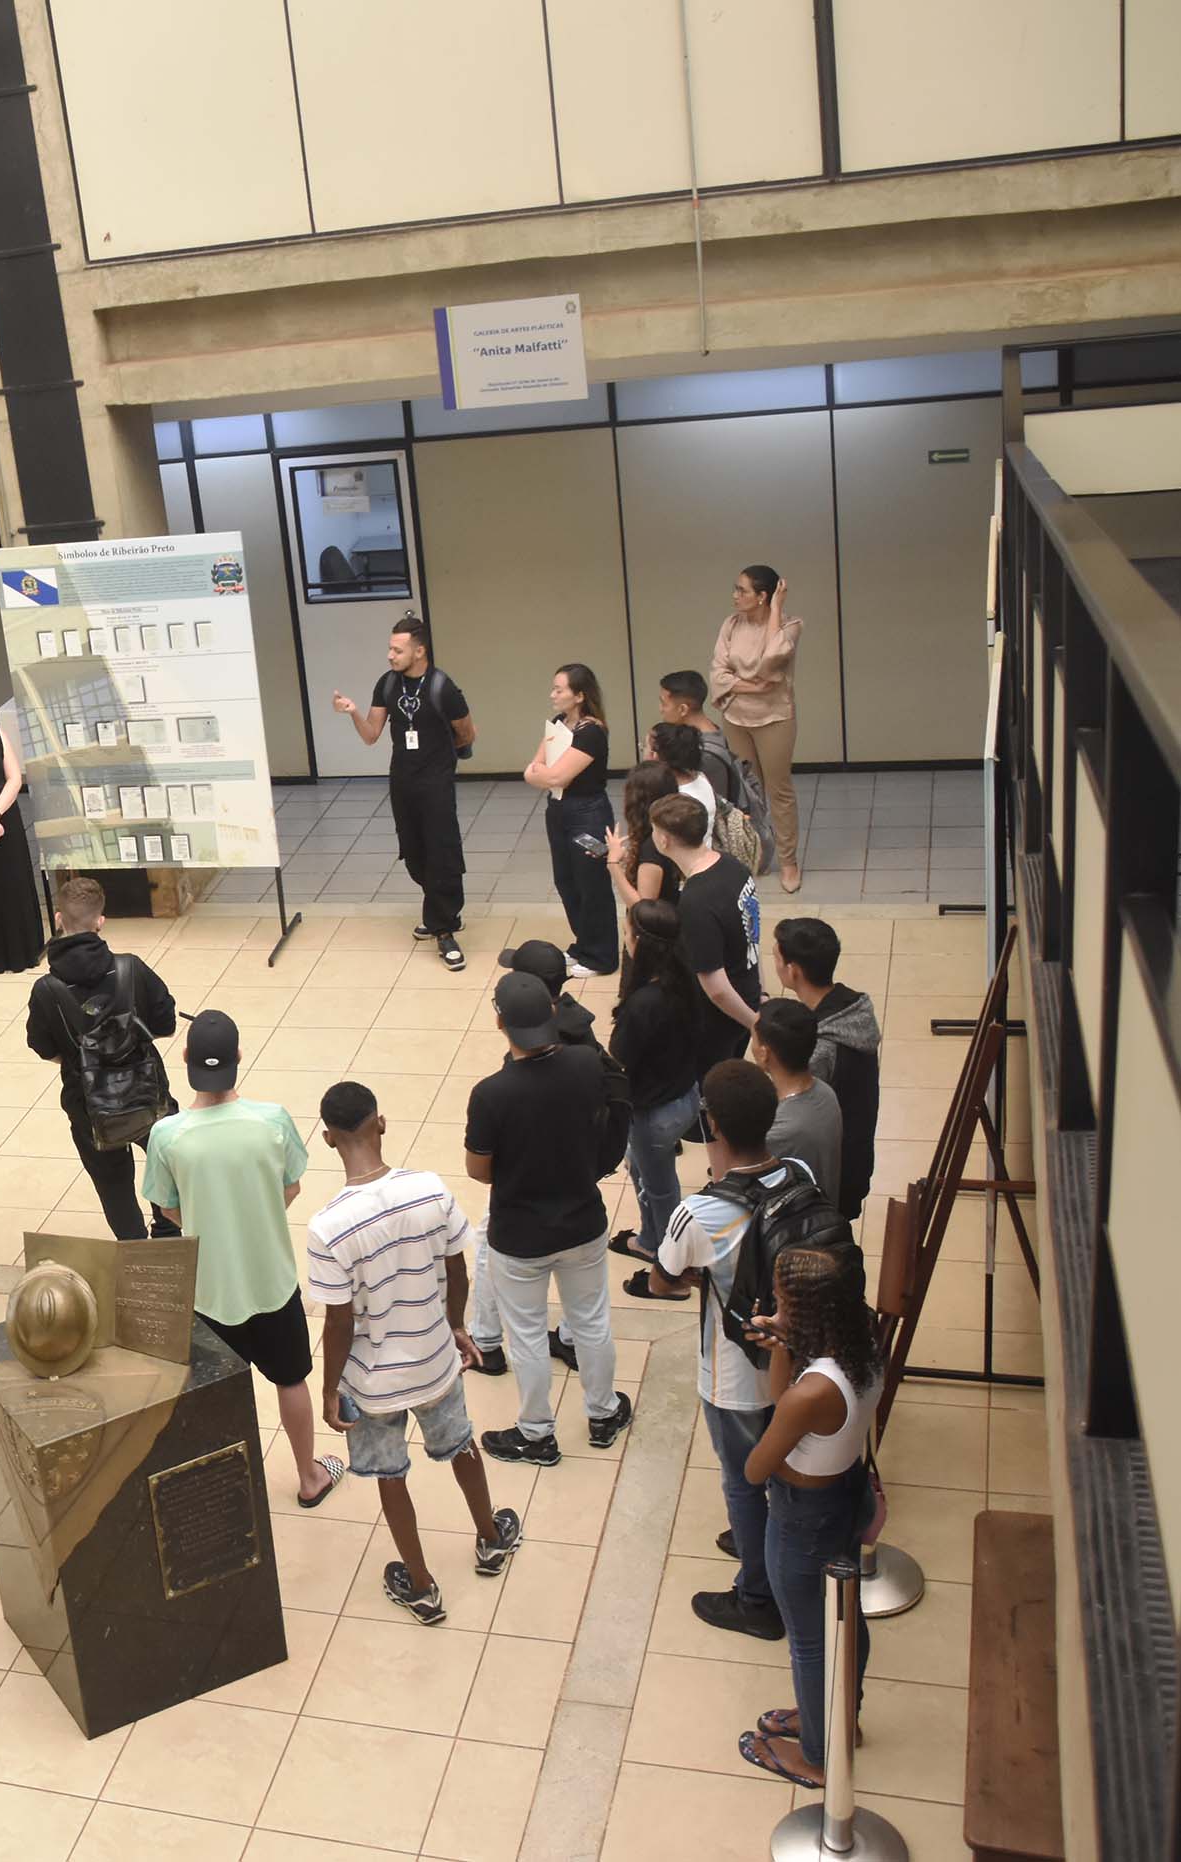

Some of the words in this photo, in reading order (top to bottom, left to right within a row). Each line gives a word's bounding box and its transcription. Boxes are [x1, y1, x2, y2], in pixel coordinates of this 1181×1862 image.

[473, 327, 500, 337] GALERIA
[99, 547, 110, 556] de
[112, 545, 150, 556] Ribeirão
[152, 544, 175, 553] Preto
